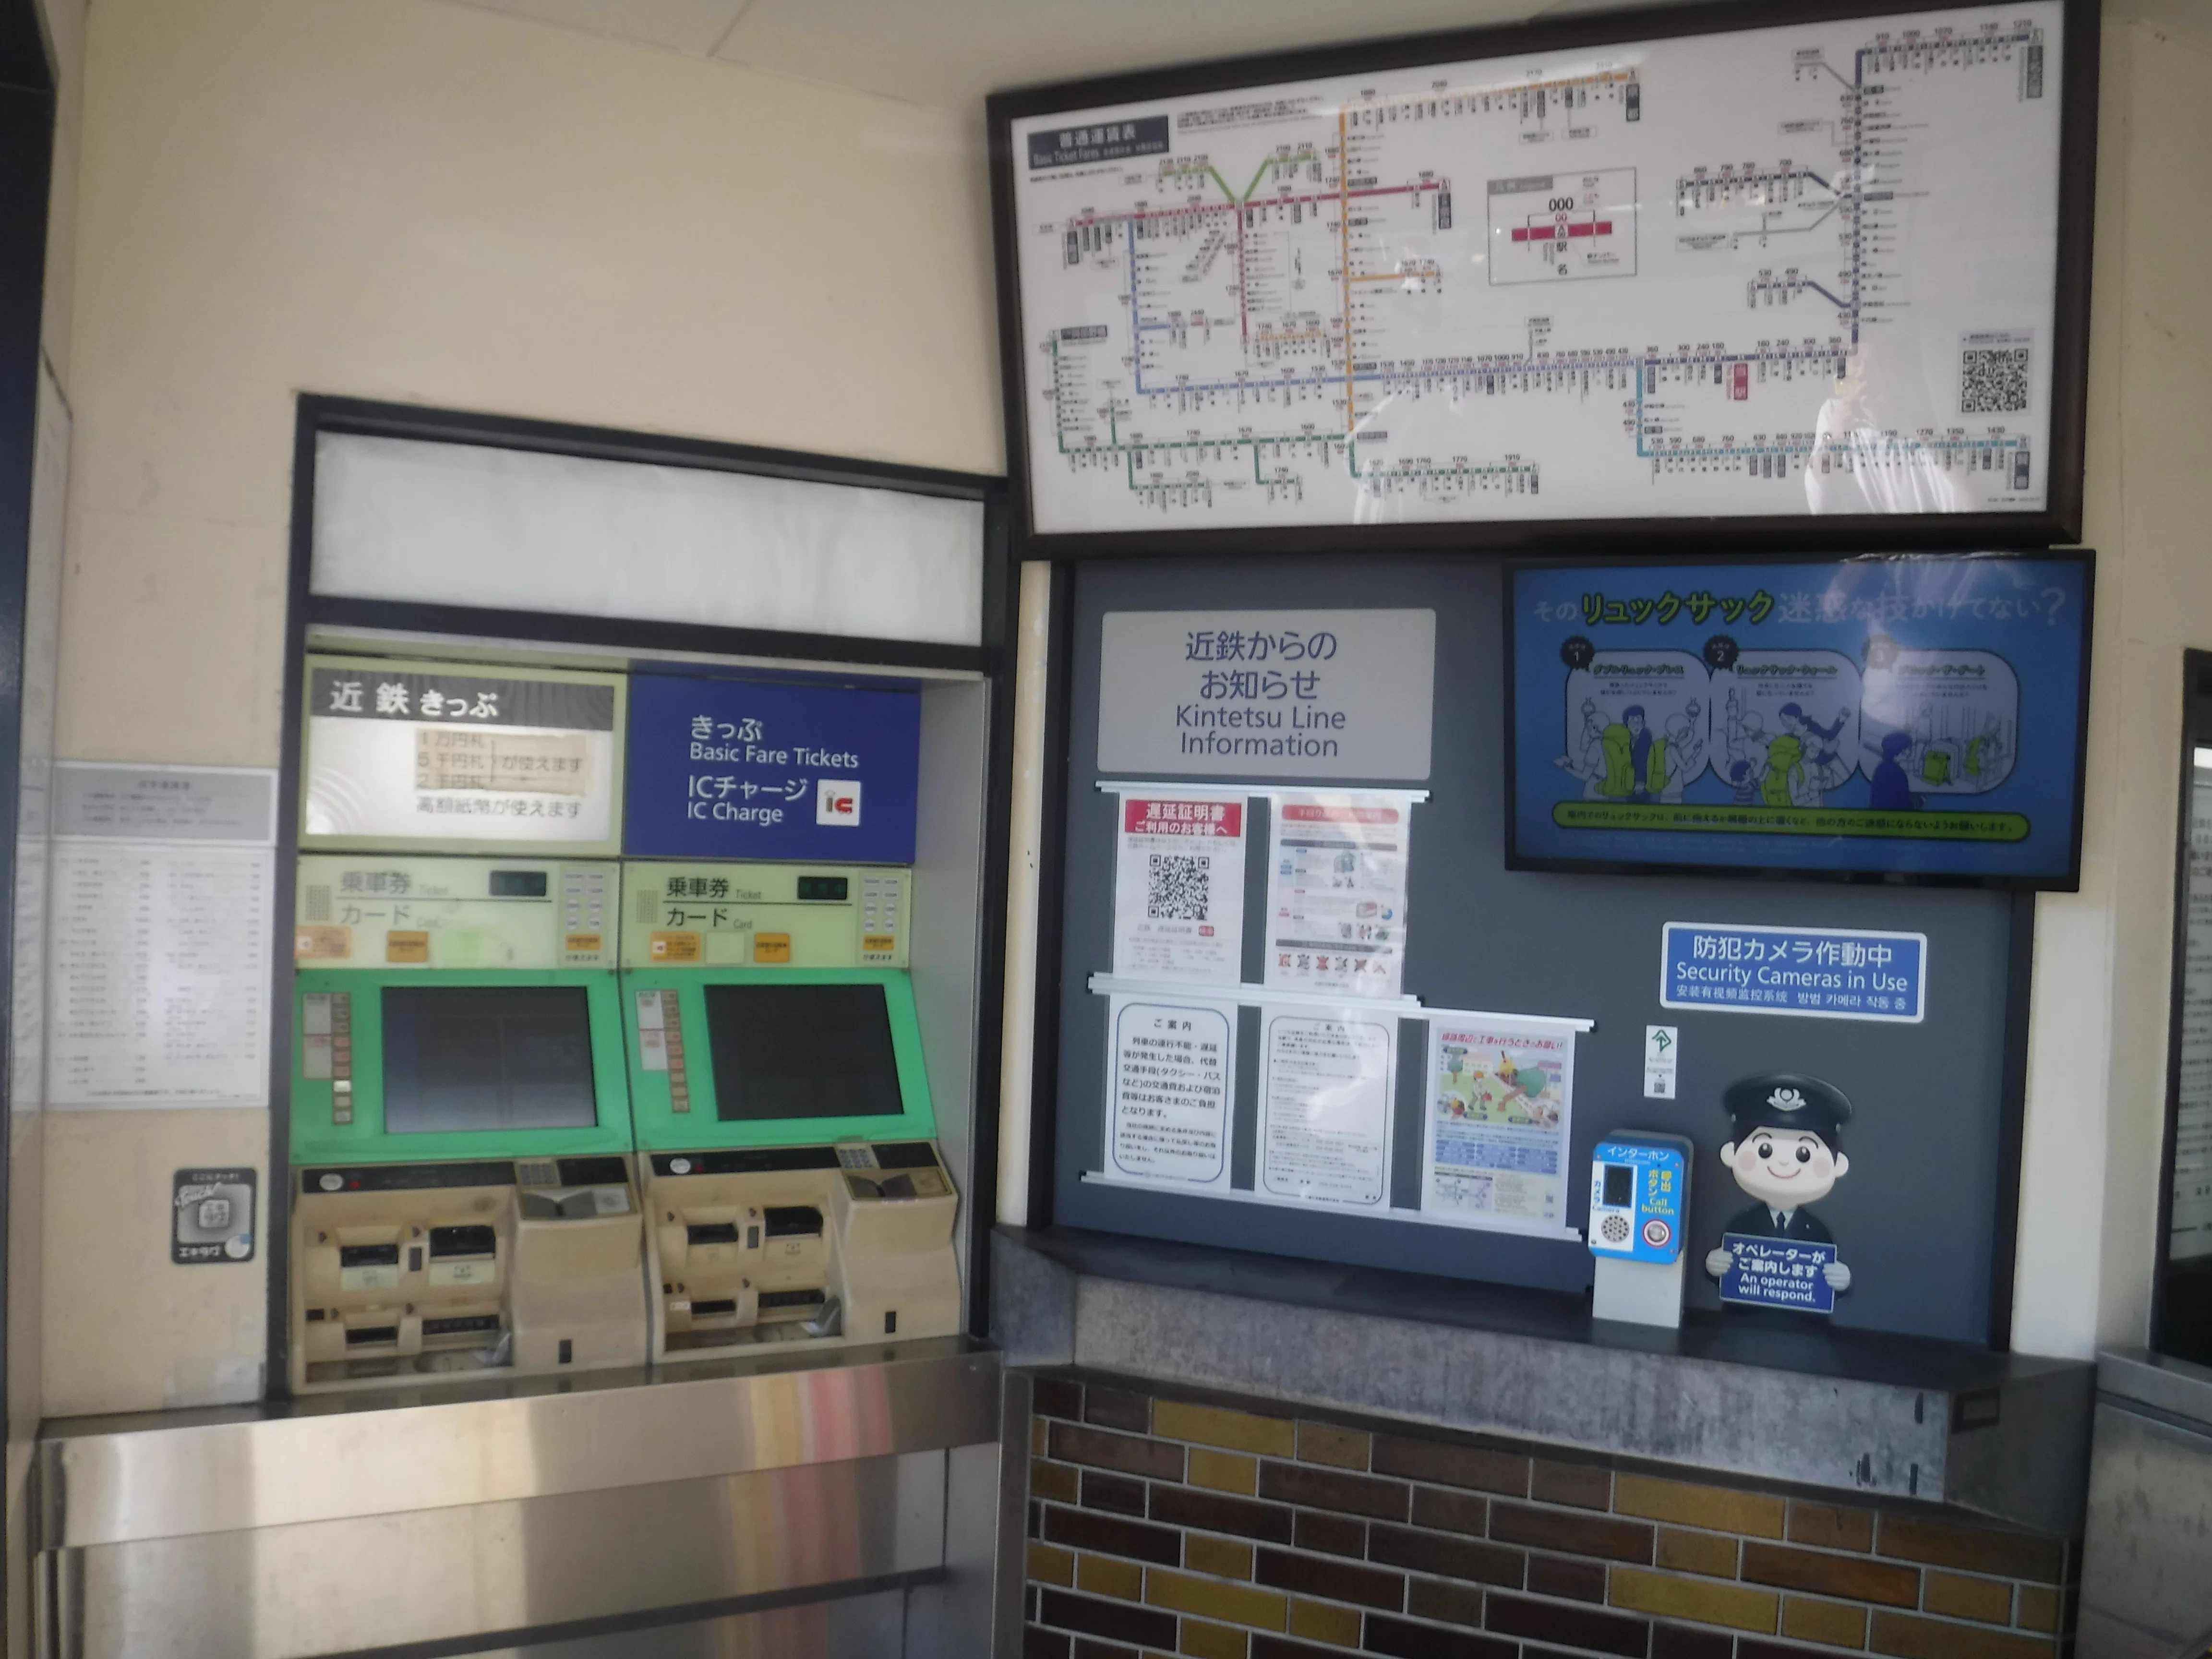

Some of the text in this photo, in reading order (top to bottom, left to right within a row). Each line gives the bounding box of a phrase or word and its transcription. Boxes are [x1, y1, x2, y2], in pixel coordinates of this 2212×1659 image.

[1185, 630, 1337, 661] 近鉄からの
[1717, 650, 1724, 661] 2
[1200, 670, 1321, 700] お知らせ
[330, 680, 500, 719] 近鉄きっぷ
[691, 714, 764, 742] きっぷ
[1176, 704, 1346, 730] Kintetsu Line
[689, 741, 859, 769] Basic Fare Tickets
[1180, 731, 1338, 757] Information
[687, 774, 809, 801] ICチャージ
[686, 801, 783, 827] IC Charge
[1146, 802, 1226, 821] 遅延証明書
[1134, 820, 1228, 836] ご利用のお客様へ
[340, 871, 411, 894] 乗車券
[666, 876, 729, 898] 乗車券
[735, 889, 762, 900] Ticket
[340, 904, 410, 925] カード
[666, 907, 728, 927] カード
[733, 918, 753, 929] Card
[1693, 935, 1892, 969] 防犯カメラ作動中
[1676, 962, 1908, 992] Security Cameras in Use
[1826, 994, 1862, 1007] 카메라
[1154, 1018, 1192, 1032] ご案内
[1607, 1146, 1670, 1161] インターホン
[1648, 1169, 1659, 1197] ボタン
[1642, 1203, 1675, 1215] button
[1649, 1197, 1668, 1206] Call
[1731, 1241, 1826, 1264] オペレーターが
[1738, 1256, 1818, 1278] ご案内します
[1740, 1272, 1814, 1291] An operator
[1738, 1284, 1816, 1303] will respond.
